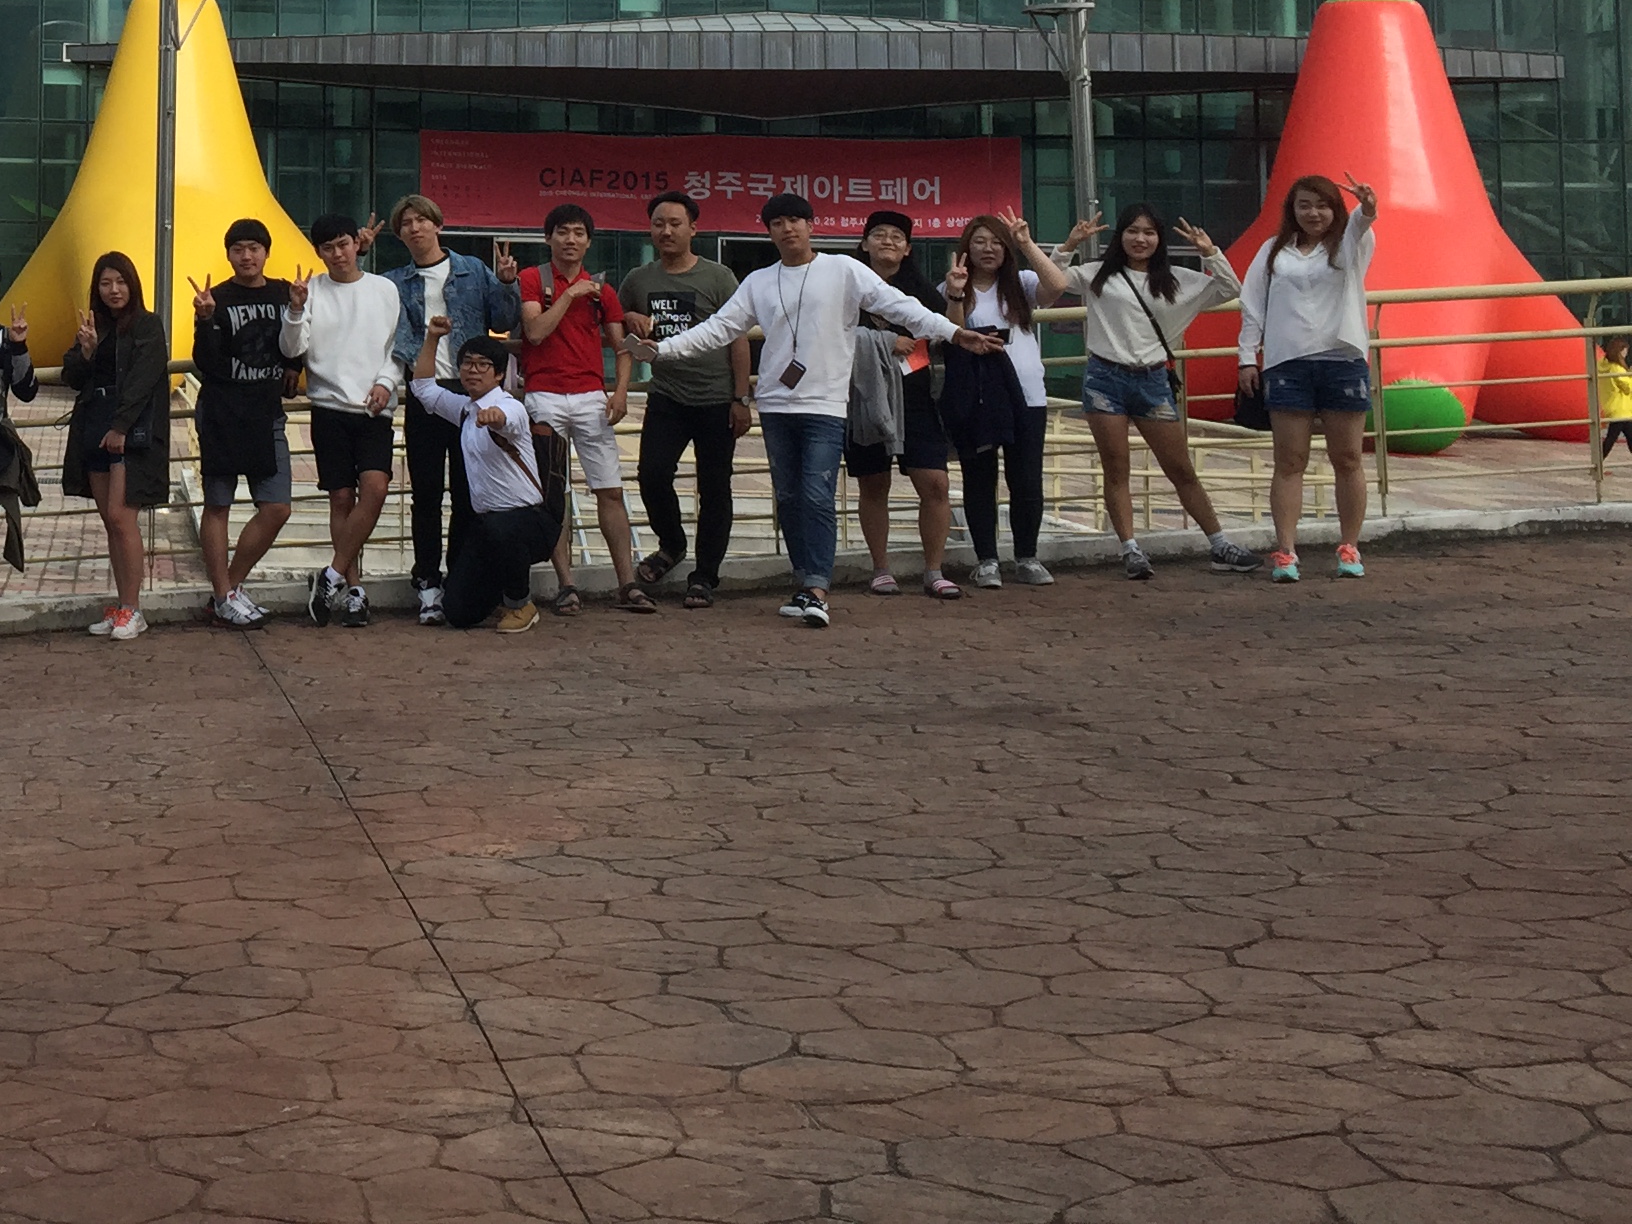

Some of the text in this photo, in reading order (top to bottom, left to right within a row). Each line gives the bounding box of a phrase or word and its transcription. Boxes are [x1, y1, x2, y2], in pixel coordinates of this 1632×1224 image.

[539, 167, 668, 191] CIAF2015
[684, 171, 941, 205] 청주국제아트페어
[651, 299, 678, 310] WELT
